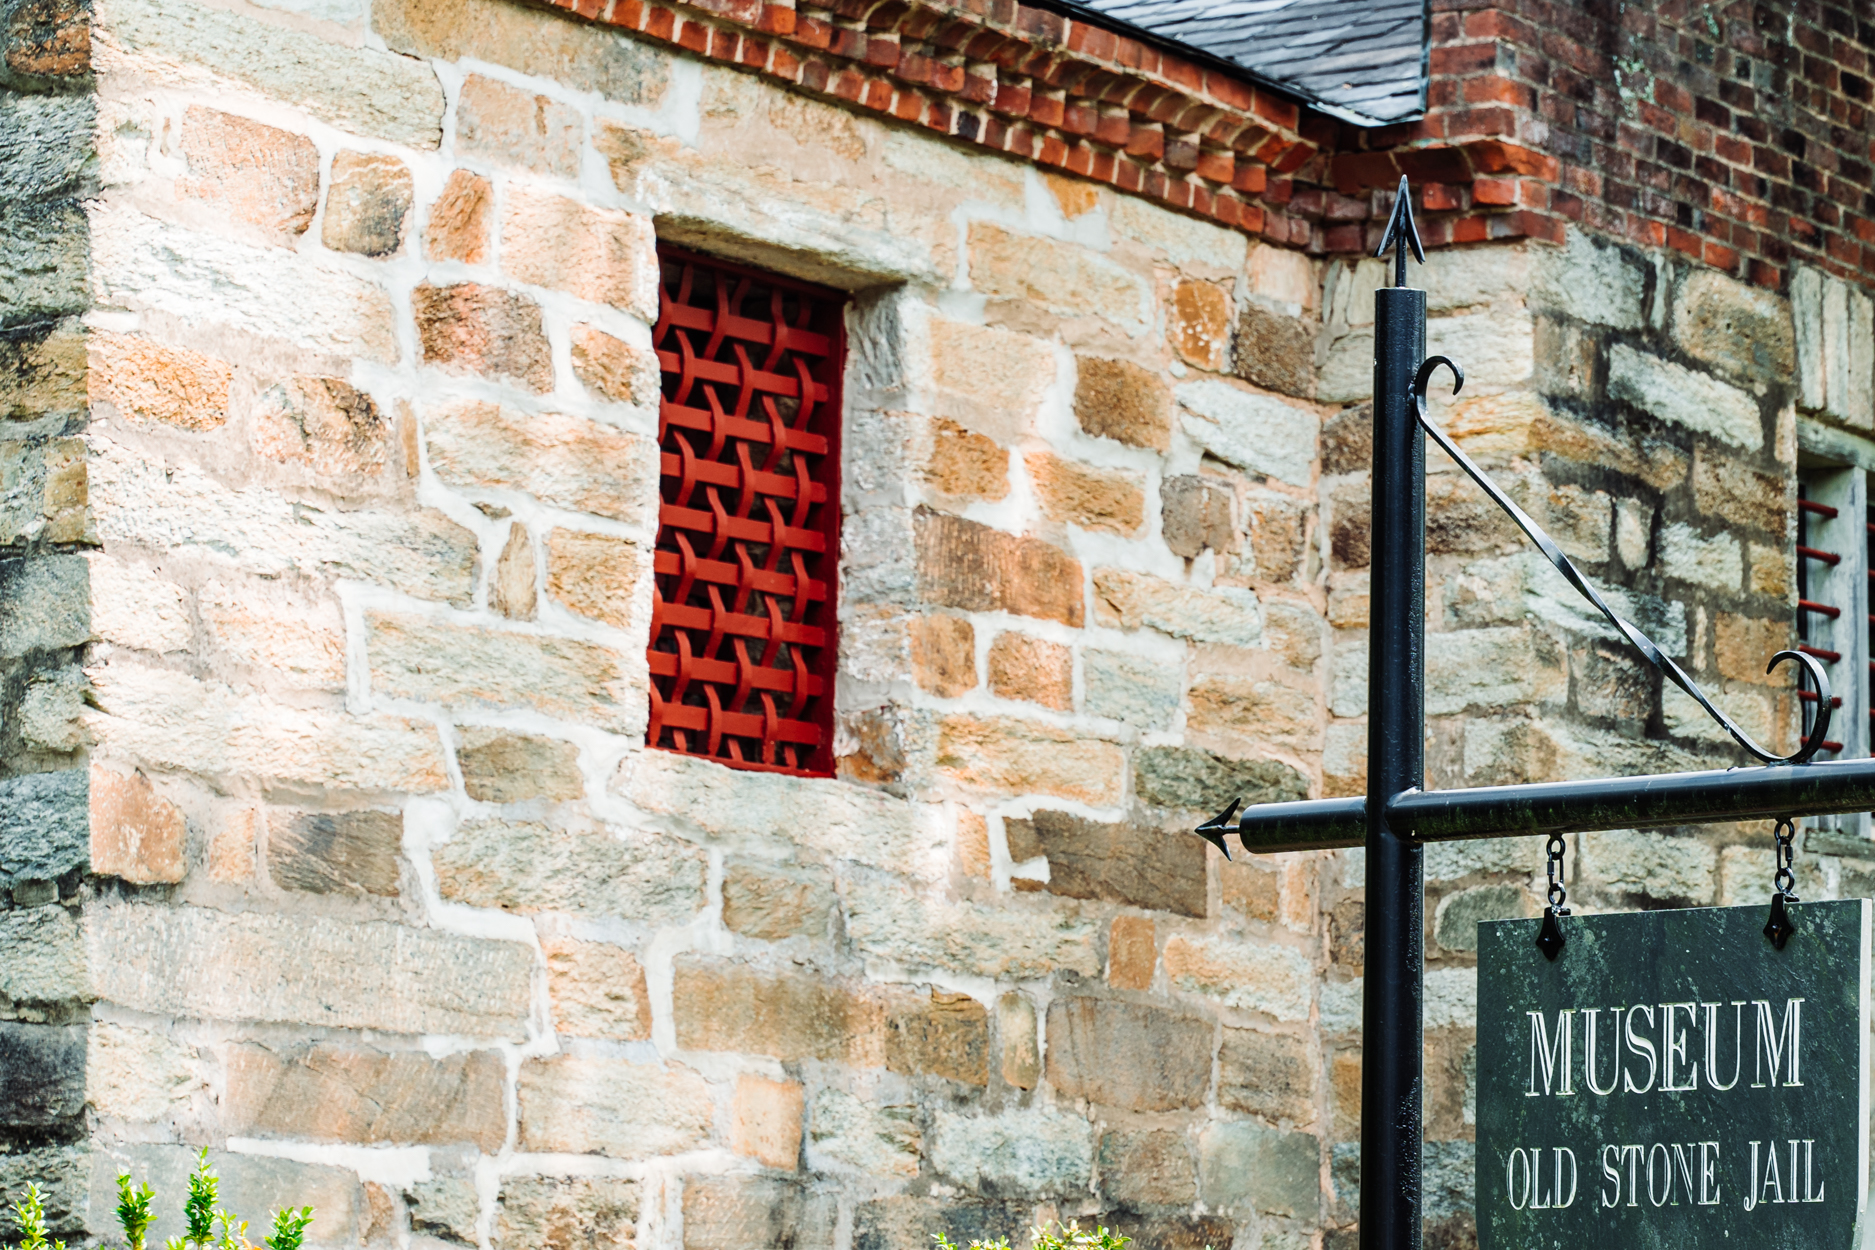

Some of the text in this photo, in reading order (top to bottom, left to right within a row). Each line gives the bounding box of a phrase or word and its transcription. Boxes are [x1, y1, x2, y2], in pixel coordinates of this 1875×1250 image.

[1525, 997, 1805, 1097] MUSEUM
[1506, 1138, 1825, 1212] OLD STONE JAIL
